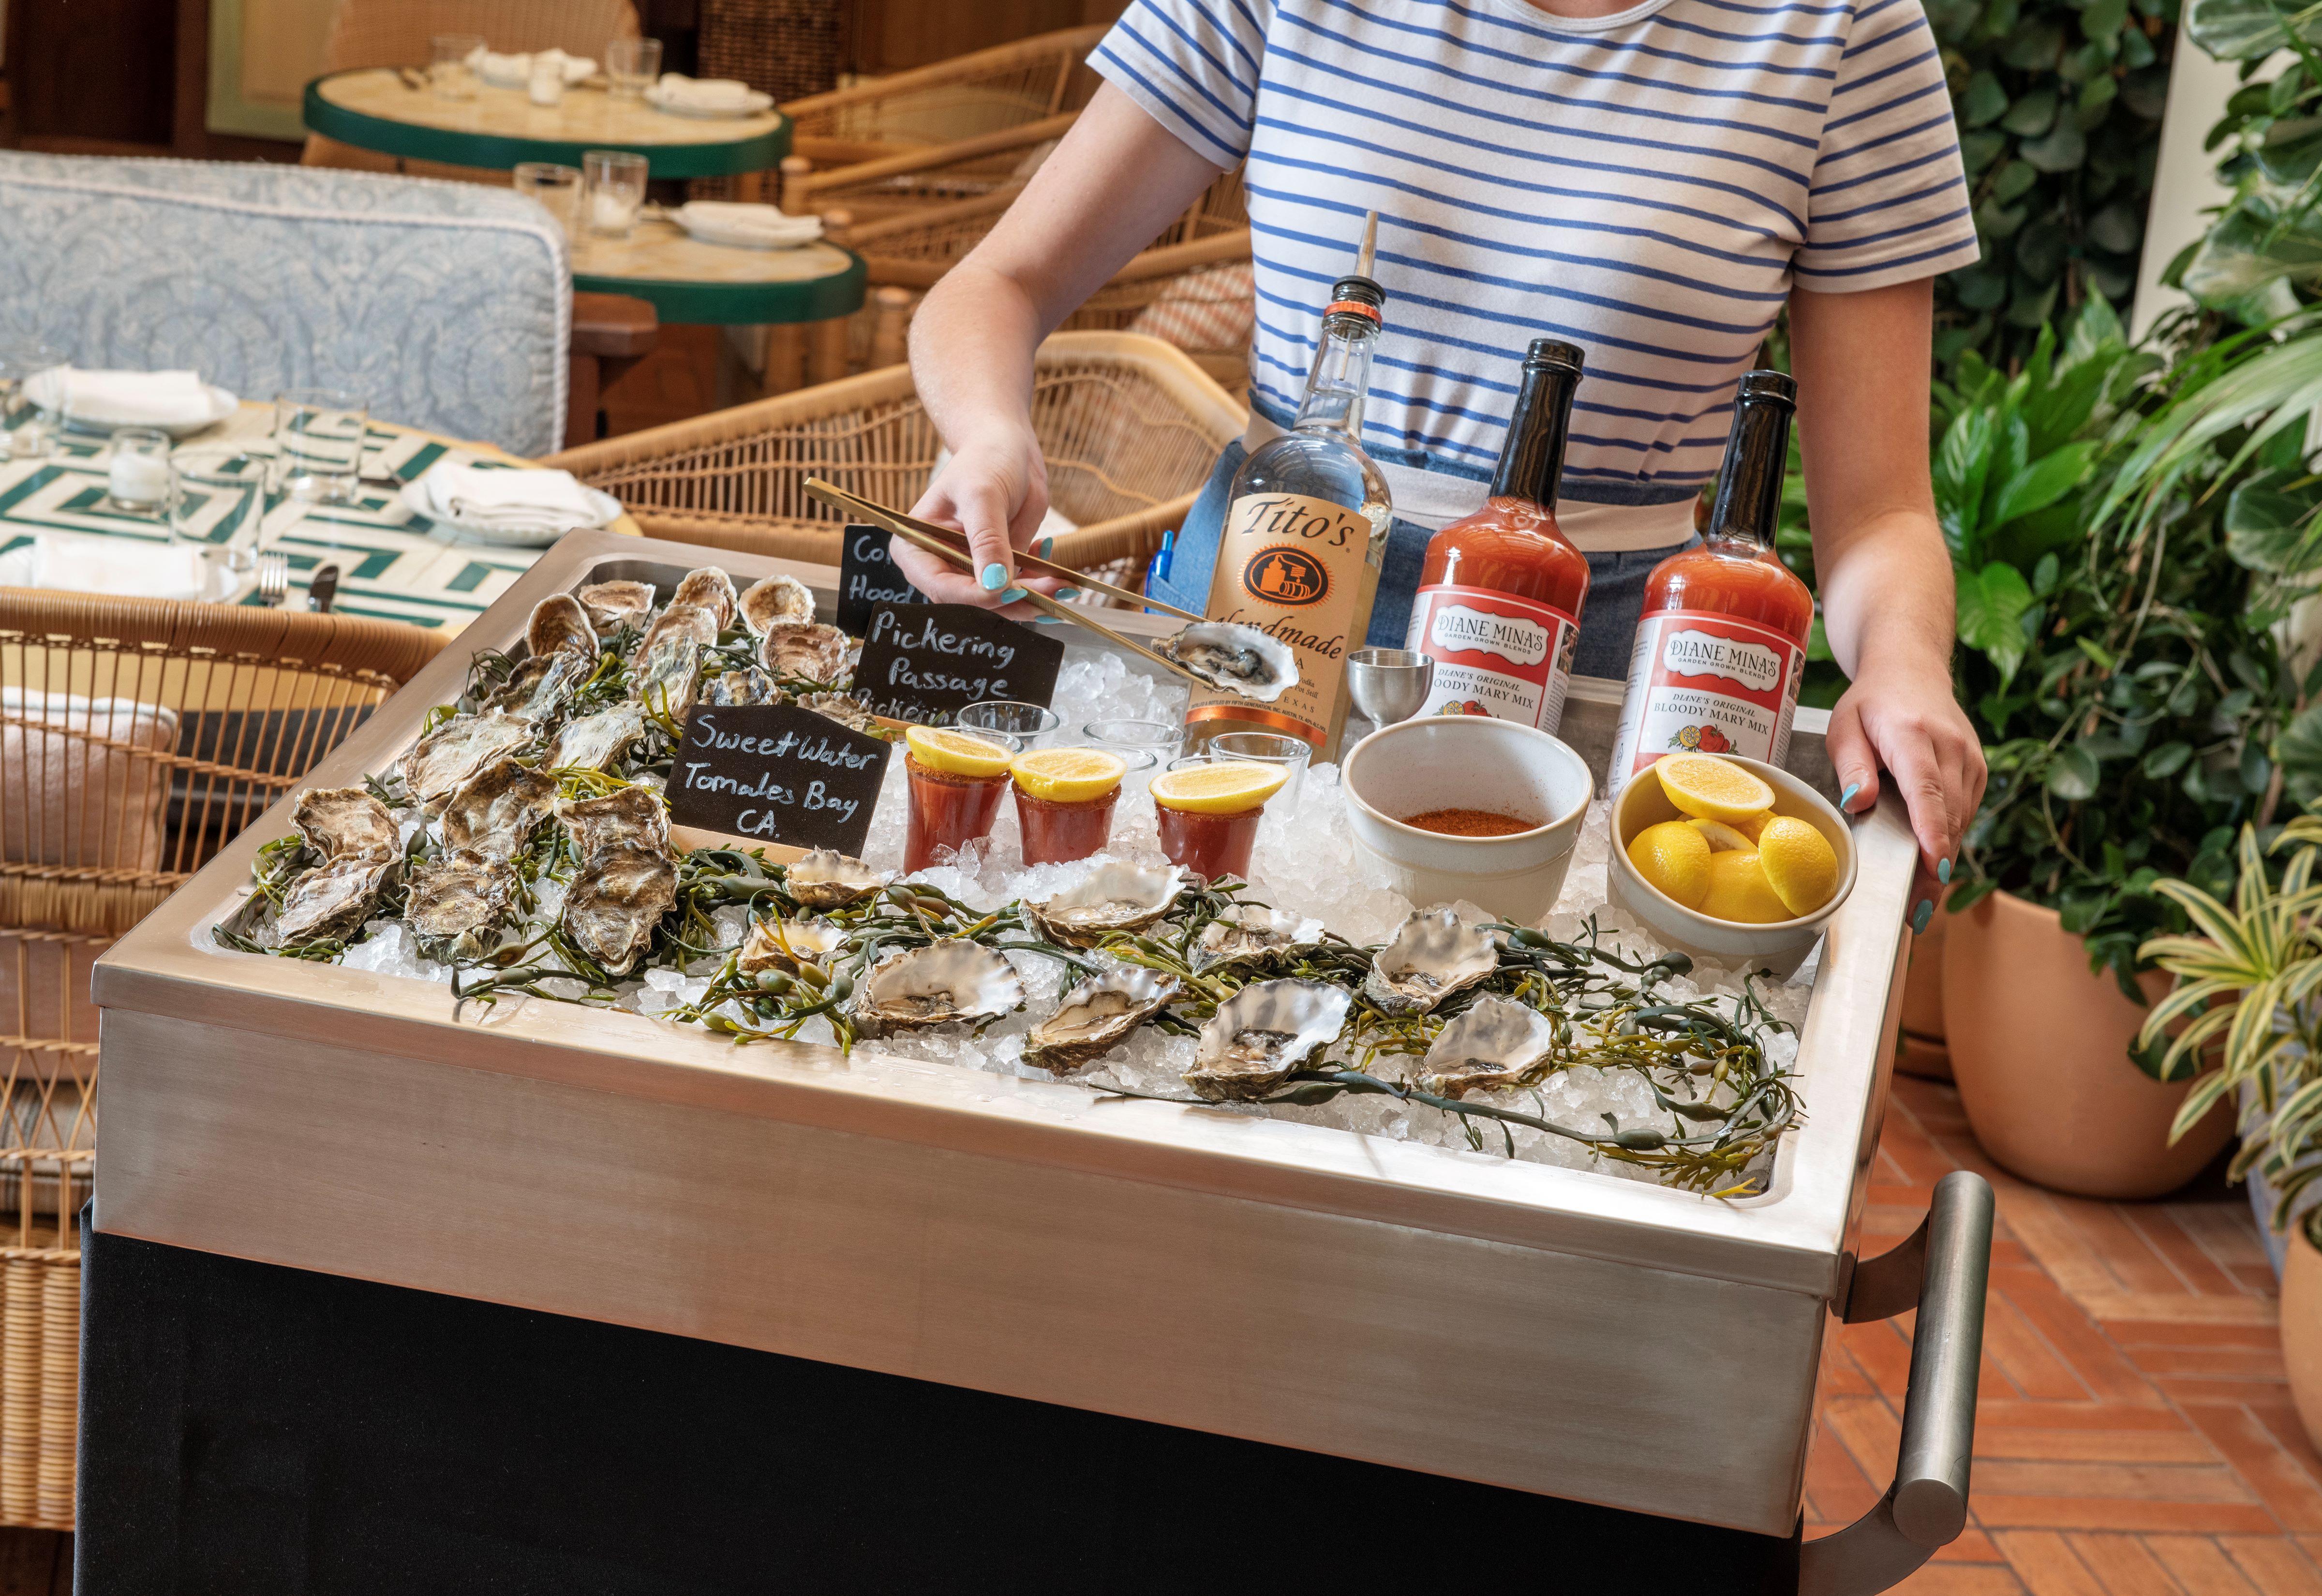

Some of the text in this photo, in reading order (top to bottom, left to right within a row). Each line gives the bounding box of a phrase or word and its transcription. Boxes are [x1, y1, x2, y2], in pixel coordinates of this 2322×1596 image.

[1241, 498, 1354, 546] Tito's
[849, 575, 915, 603] Hood
[872, 611, 1015, 669] Pickering
[1216, 609, 1344, 659] dmade
[1438, 615, 1489, 636] DIANE
[1493, 624, 1542, 651] MINA'S
[1474, 637, 1500, 646] GROWN
[1504, 643, 1531, 654] BLENDS
[1670, 640, 1725, 661] DIANE
[1729, 649, 1776, 677] MINA'S
[1710, 662, 1735, 671] GROWN
[1740, 668, 1765, 680] BLENDS
[889, 657, 1007, 701] Passage
[1434, 679, 1533, 709] OODY MARY MIX
[1438, 669, 1520, 691] DIANE'S ORIGINAL
[1280, 695, 1315, 713] EXAS
[1653, 703, 1769, 735] BLOODY MARY MIX
[1672, 694, 1755, 717] DIANE'S ORIGINAL
[685, 762, 859, 823] Tomales Bay
[737, 809, 780, 839] CA.
